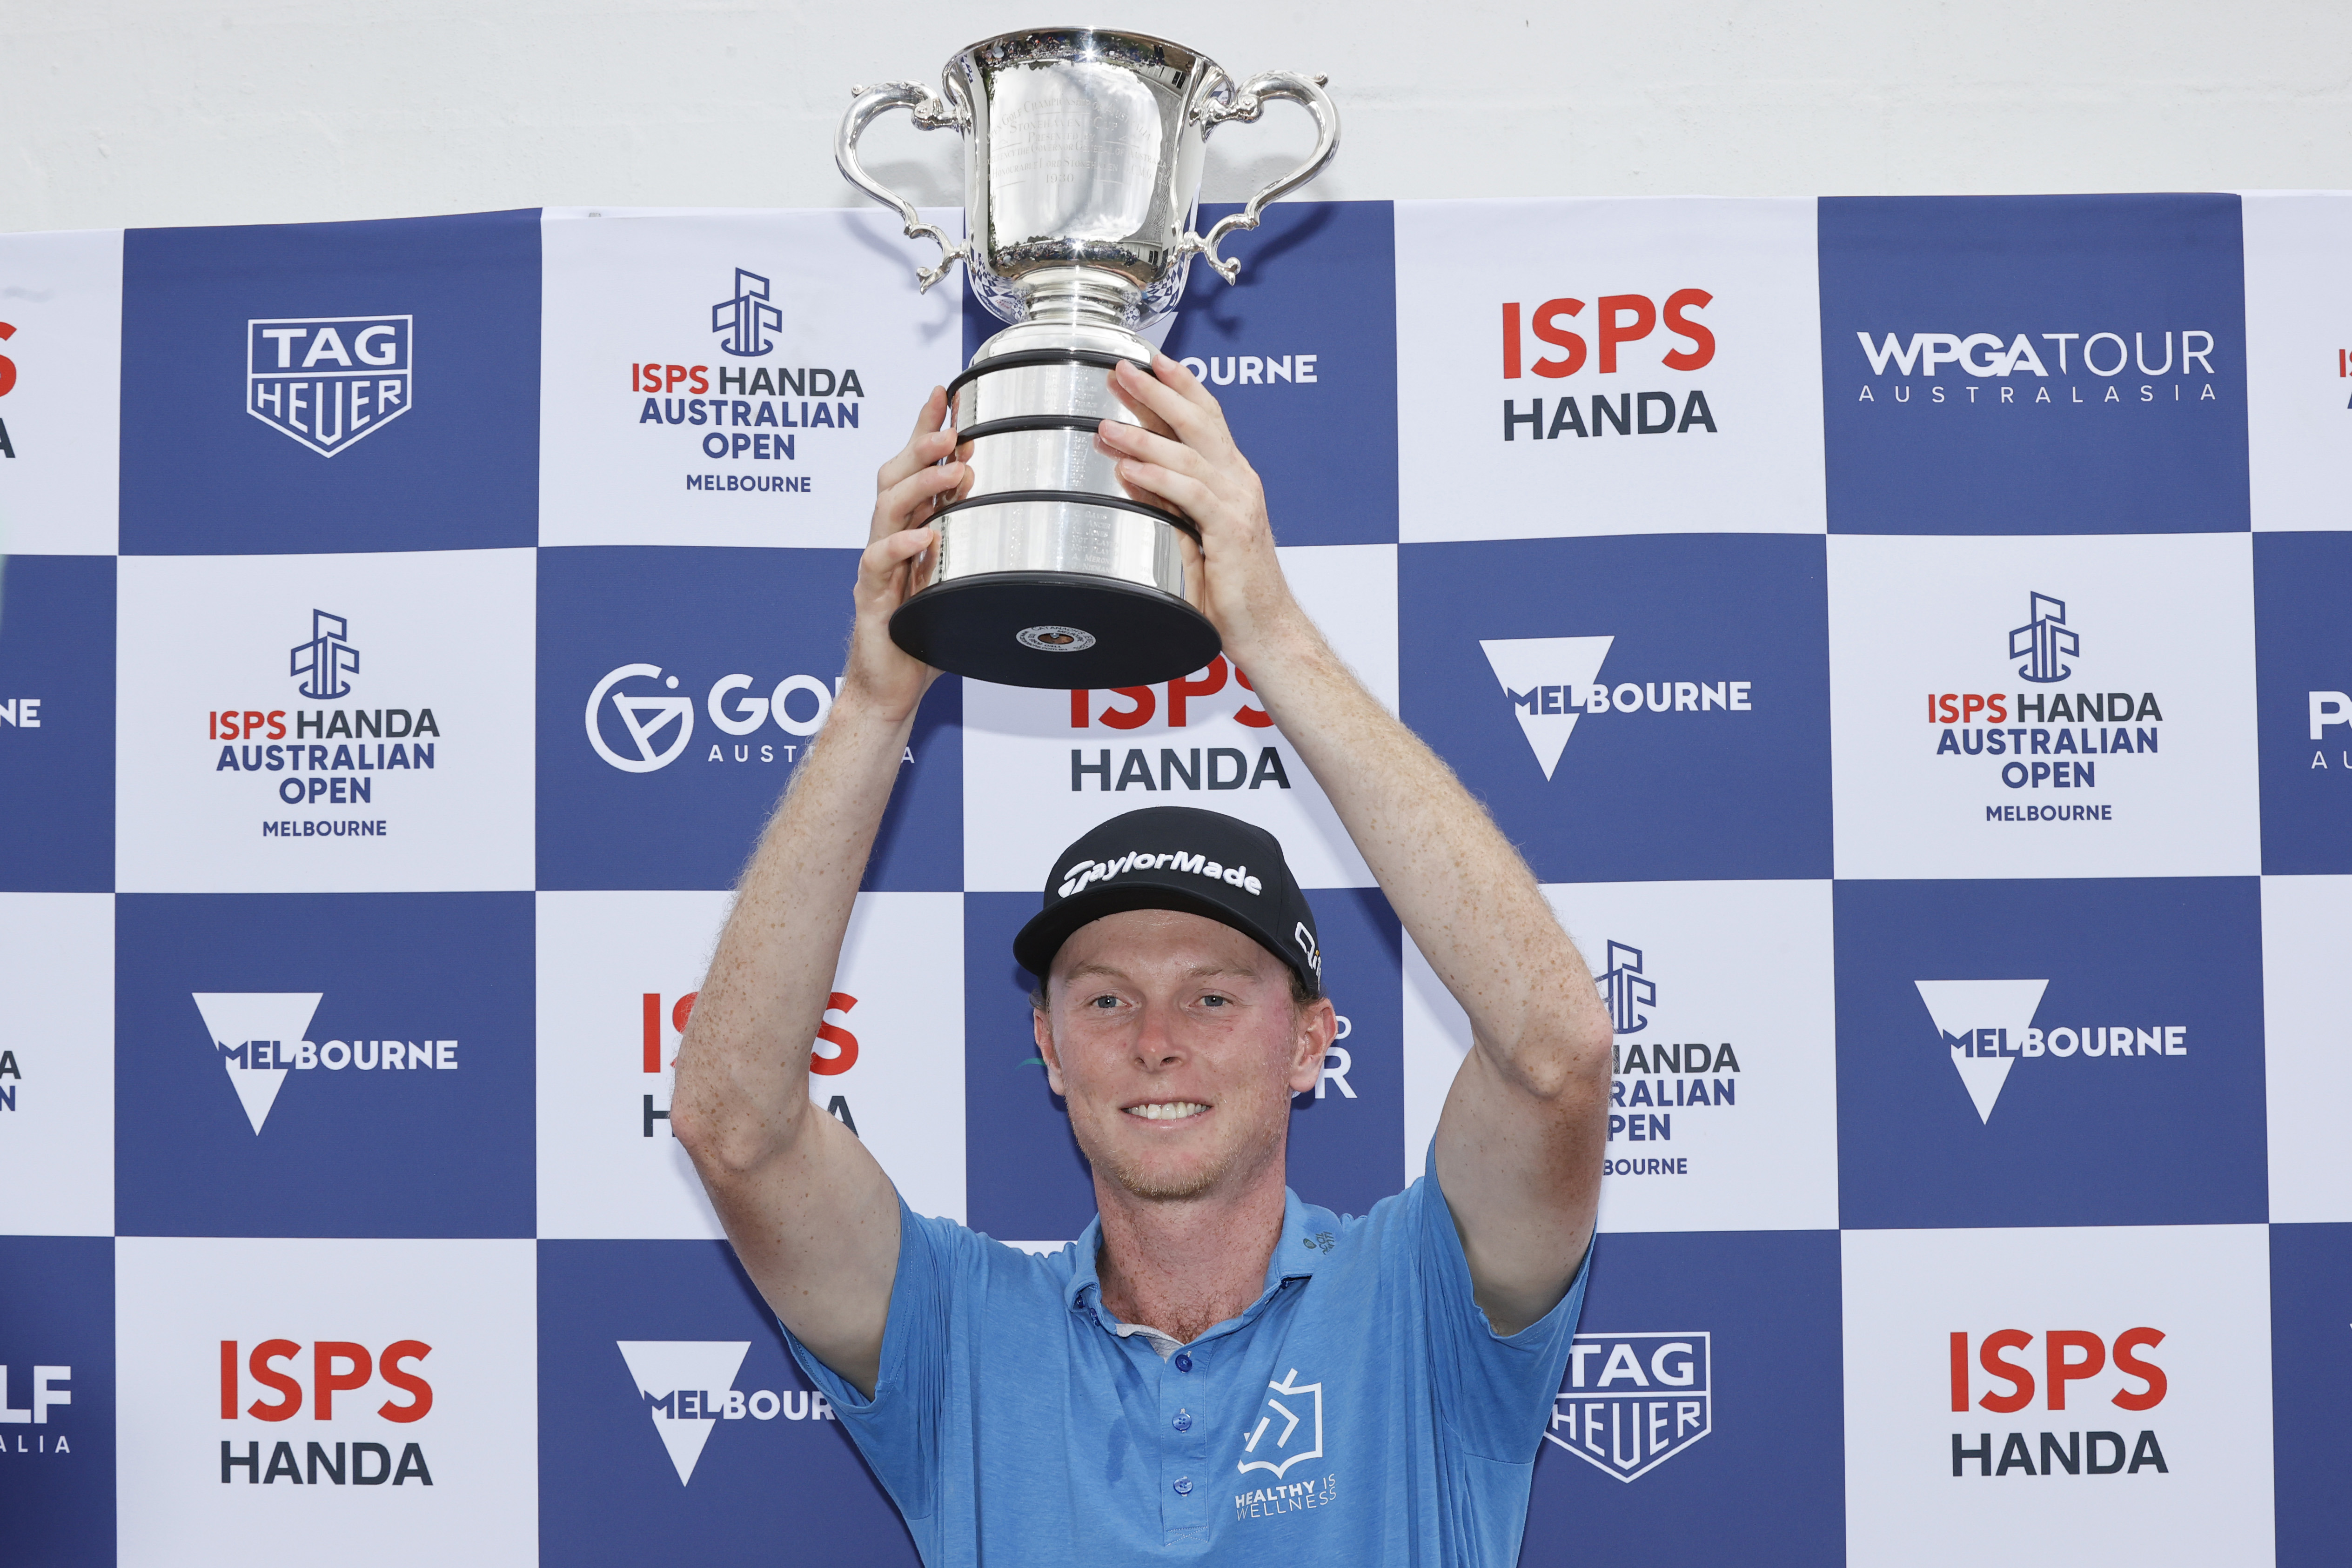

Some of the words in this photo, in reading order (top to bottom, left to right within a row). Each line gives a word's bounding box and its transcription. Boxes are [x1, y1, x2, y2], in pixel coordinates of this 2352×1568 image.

[262, 325, 396, 368] TAG
[1502, 288, 1715, 379] ISPS
[632, 362, 709, 395] ISPS
[719, 366, 864, 398] HANDA
[1179, 354, 1318, 386] OURNE
[1858, 383, 2216, 403] AUSTRALASIA
[257, 380, 401, 446] HEUER
[639, 398, 858, 428] AUSTRALIAN
[1504, 390, 1717, 441] HANDA
[702, 432, 795, 460] OPEN
[687, 474, 811, 492] MELBOURNE
[1507, 681, 1751, 715] MELBOURNE
[1928, 693, 2007, 724] ISPS
[2017, 692, 2163, 723] HANDA
[209, 710, 287, 741] ISPS
[297, 708, 440, 739] HANDA
[216, 743, 435, 771] AUSTRALIAN
[1936, 727, 2158, 755] AUSTRALIAN
[1072, 747, 1292, 791] HANDA
[2002, 761, 2095, 789] OPEN
[279, 777, 371, 804] OPEN
[263, 820, 387, 837] MELBOURNE
[1986, 804, 2112, 821] MELBOURNE
[1058, 851, 1262, 898] TaylorMade
[218, 1040, 458, 1070] MELBOURNE
[1943, 1026, 2187, 1058] MELBOURNE
[1610, 1079, 1735, 1107] RALIAN
[1607, 1114, 1671, 1142] PEN
[1603, 1158, 1688, 1176] BOURNE
[1569, 1342, 1694, 1387] TAG
[1950, 1327, 2168, 1414] ISPS
[221, 1339, 433, 1423] ISPS
[644, 1389, 836, 1421] MELBOUR
[1552, 1401, 1701, 1470] HEUER
[221, 1441, 434, 1486] HANDA
[1952, 1430, 2169, 1477] HANDA
[1235, 1480, 1315, 1508] HEALTHY
[1323, 1473, 1335, 1489] IS
[1237, 1486, 1337, 1521] WELLNESS
